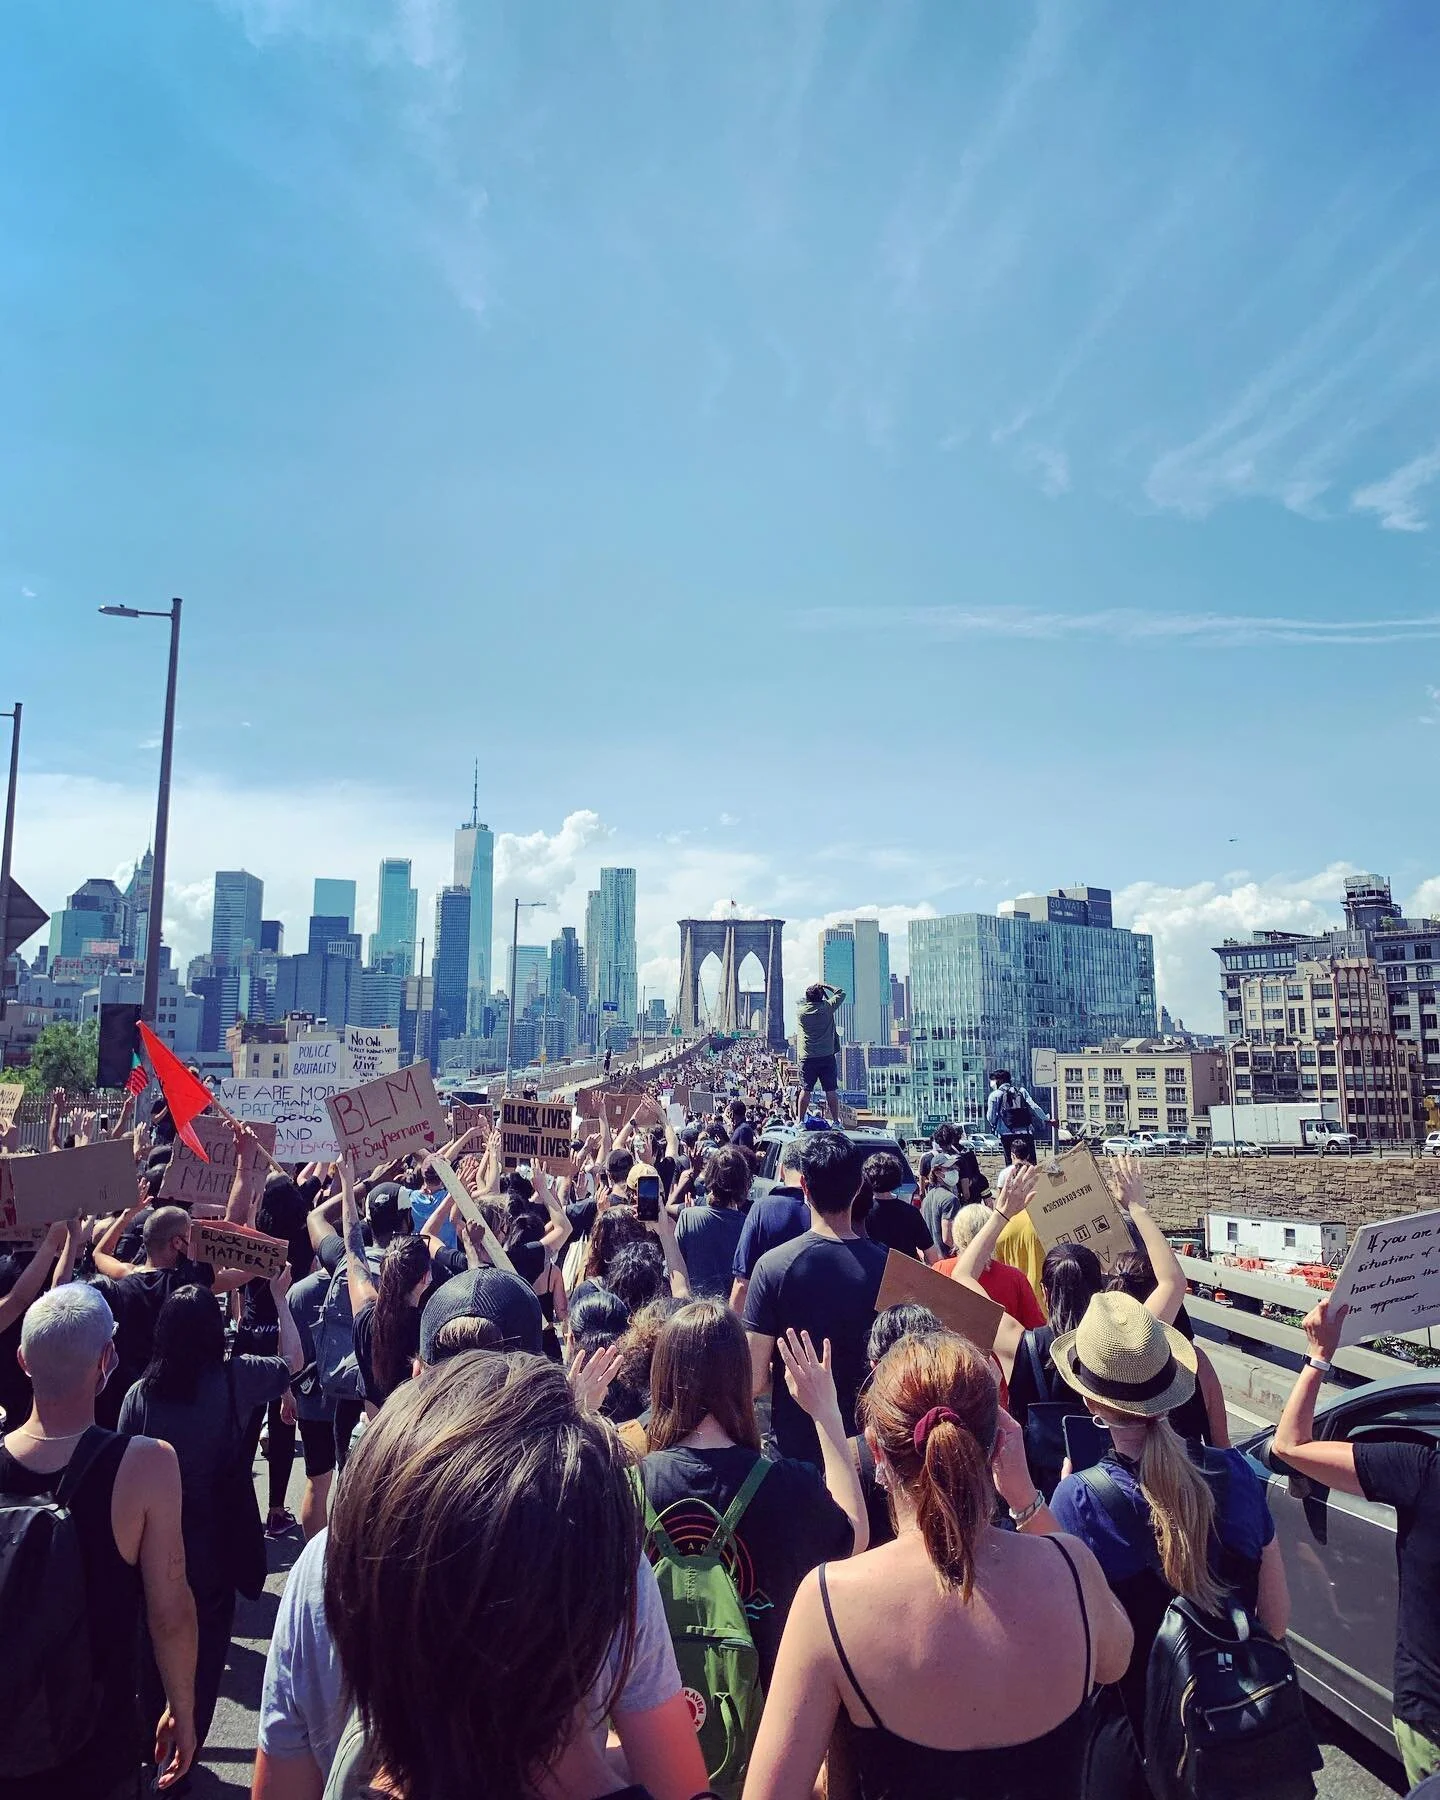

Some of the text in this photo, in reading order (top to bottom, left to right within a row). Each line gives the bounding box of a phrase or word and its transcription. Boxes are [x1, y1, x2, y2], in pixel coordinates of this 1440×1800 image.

[299, 1044, 333, 1059] POLICE
[293, 1061, 337, 1076] BRUTALITY
[222, 1084, 250, 1100] WE
[254, 1085, 294, 1100] ARE
[333, 1071, 422, 1136] BLM
[503, 1103, 572, 1130] BLACK LIVES
[503, 1132, 571, 1159] HUMAN LIVES
[201, 1229, 279, 1257] BLACK LIVES
[1367, 1231, 1383, 1254] If
[1379, 1235, 1407, 1252] you
[1411, 1229, 1432, 1240] are
[1358, 1246, 1435, 1272] situations of
[1350, 1283, 1377, 1295] have
[1420, 1268, 1440, 1277] the
